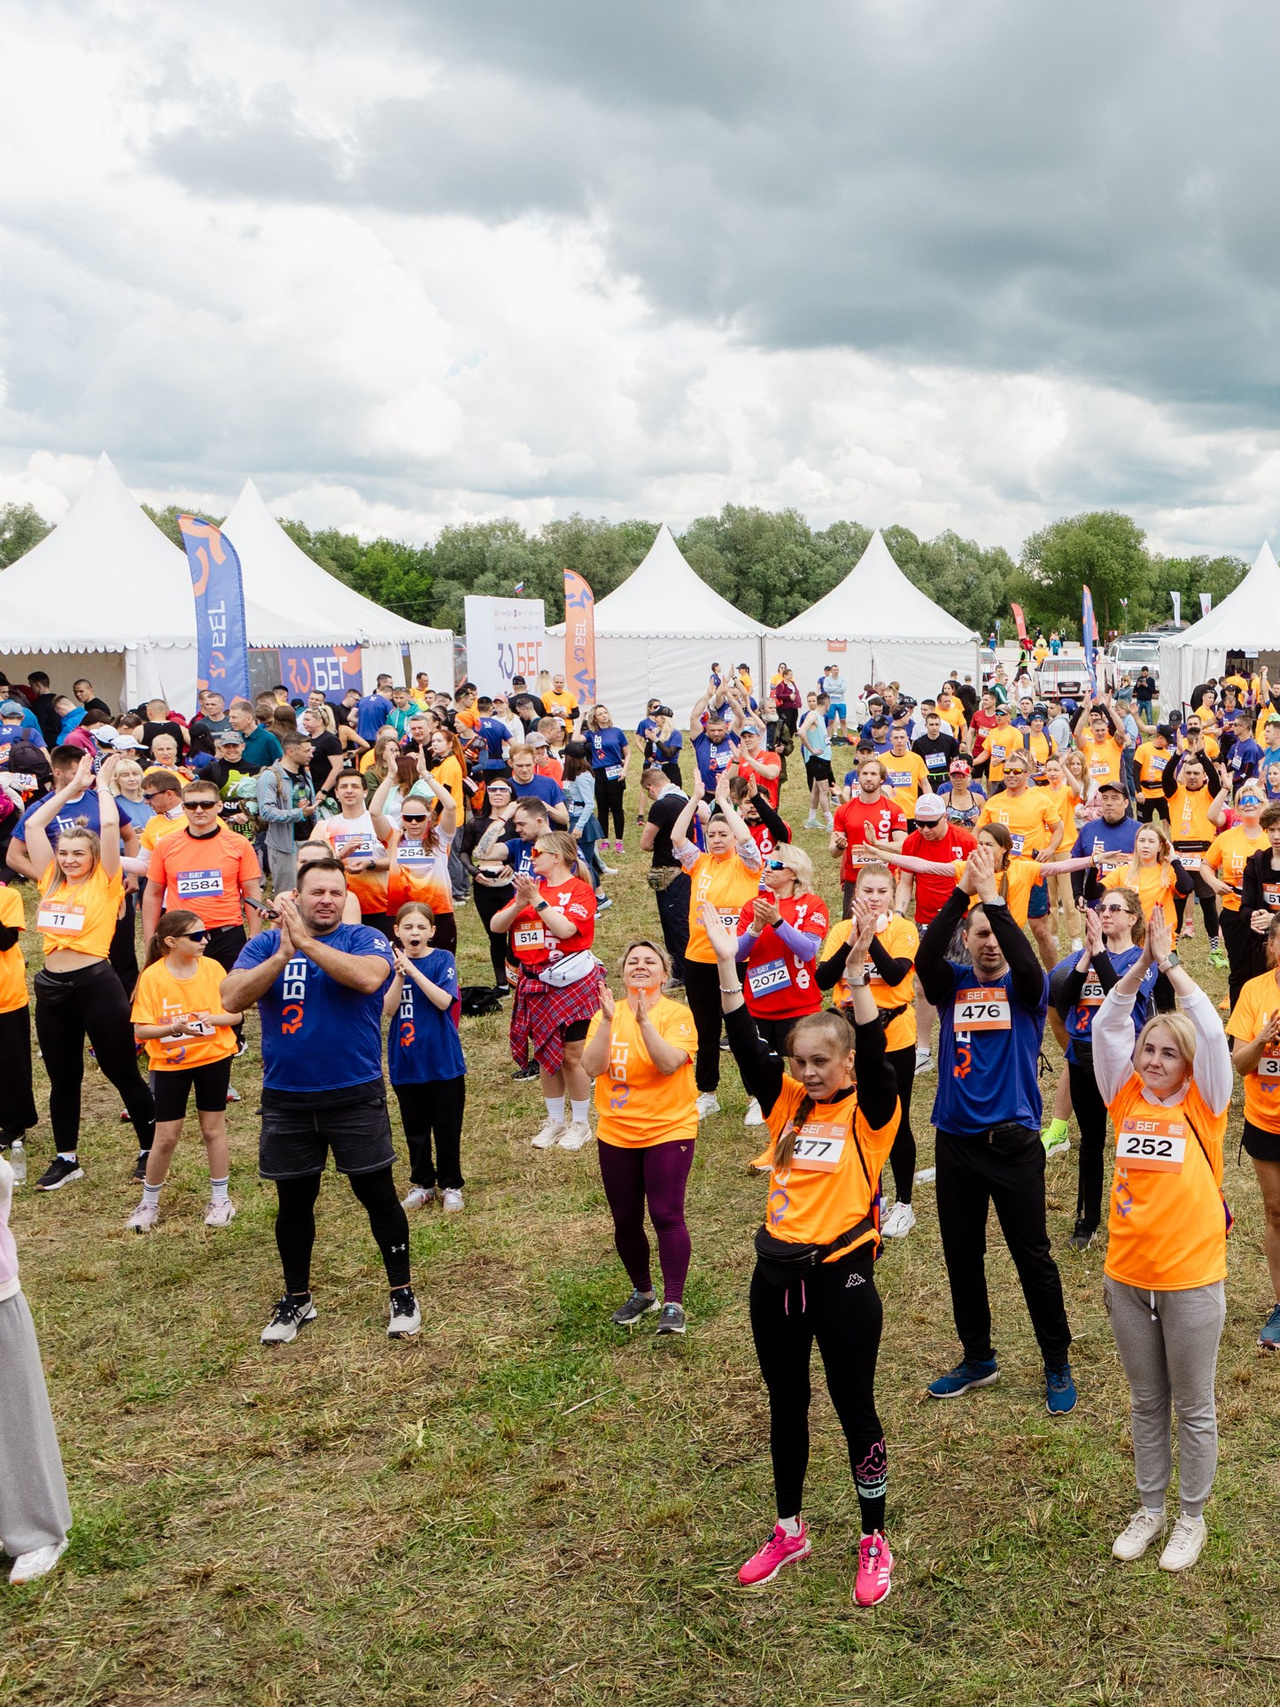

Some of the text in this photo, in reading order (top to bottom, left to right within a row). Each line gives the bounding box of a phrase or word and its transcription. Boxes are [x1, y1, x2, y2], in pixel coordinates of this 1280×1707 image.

[400, 849, 433, 857] 2542
[180, 880, 220, 891] 2584
[1270, 894, 1280, 903] 51
[53, 914, 65, 926] 11
[520, 932, 538, 943] 514
[752, 970, 787, 989] 2072
[967, 991, 987, 1000] БЕГ
[962, 1004, 1001, 1019] 476
[611, 1033, 629, 1082] БЕГ
[1136, 1120, 1160, 1132] БЕГ
[794, 1140, 833, 1158] 477
[1126, 1138, 1173, 1157] 252
